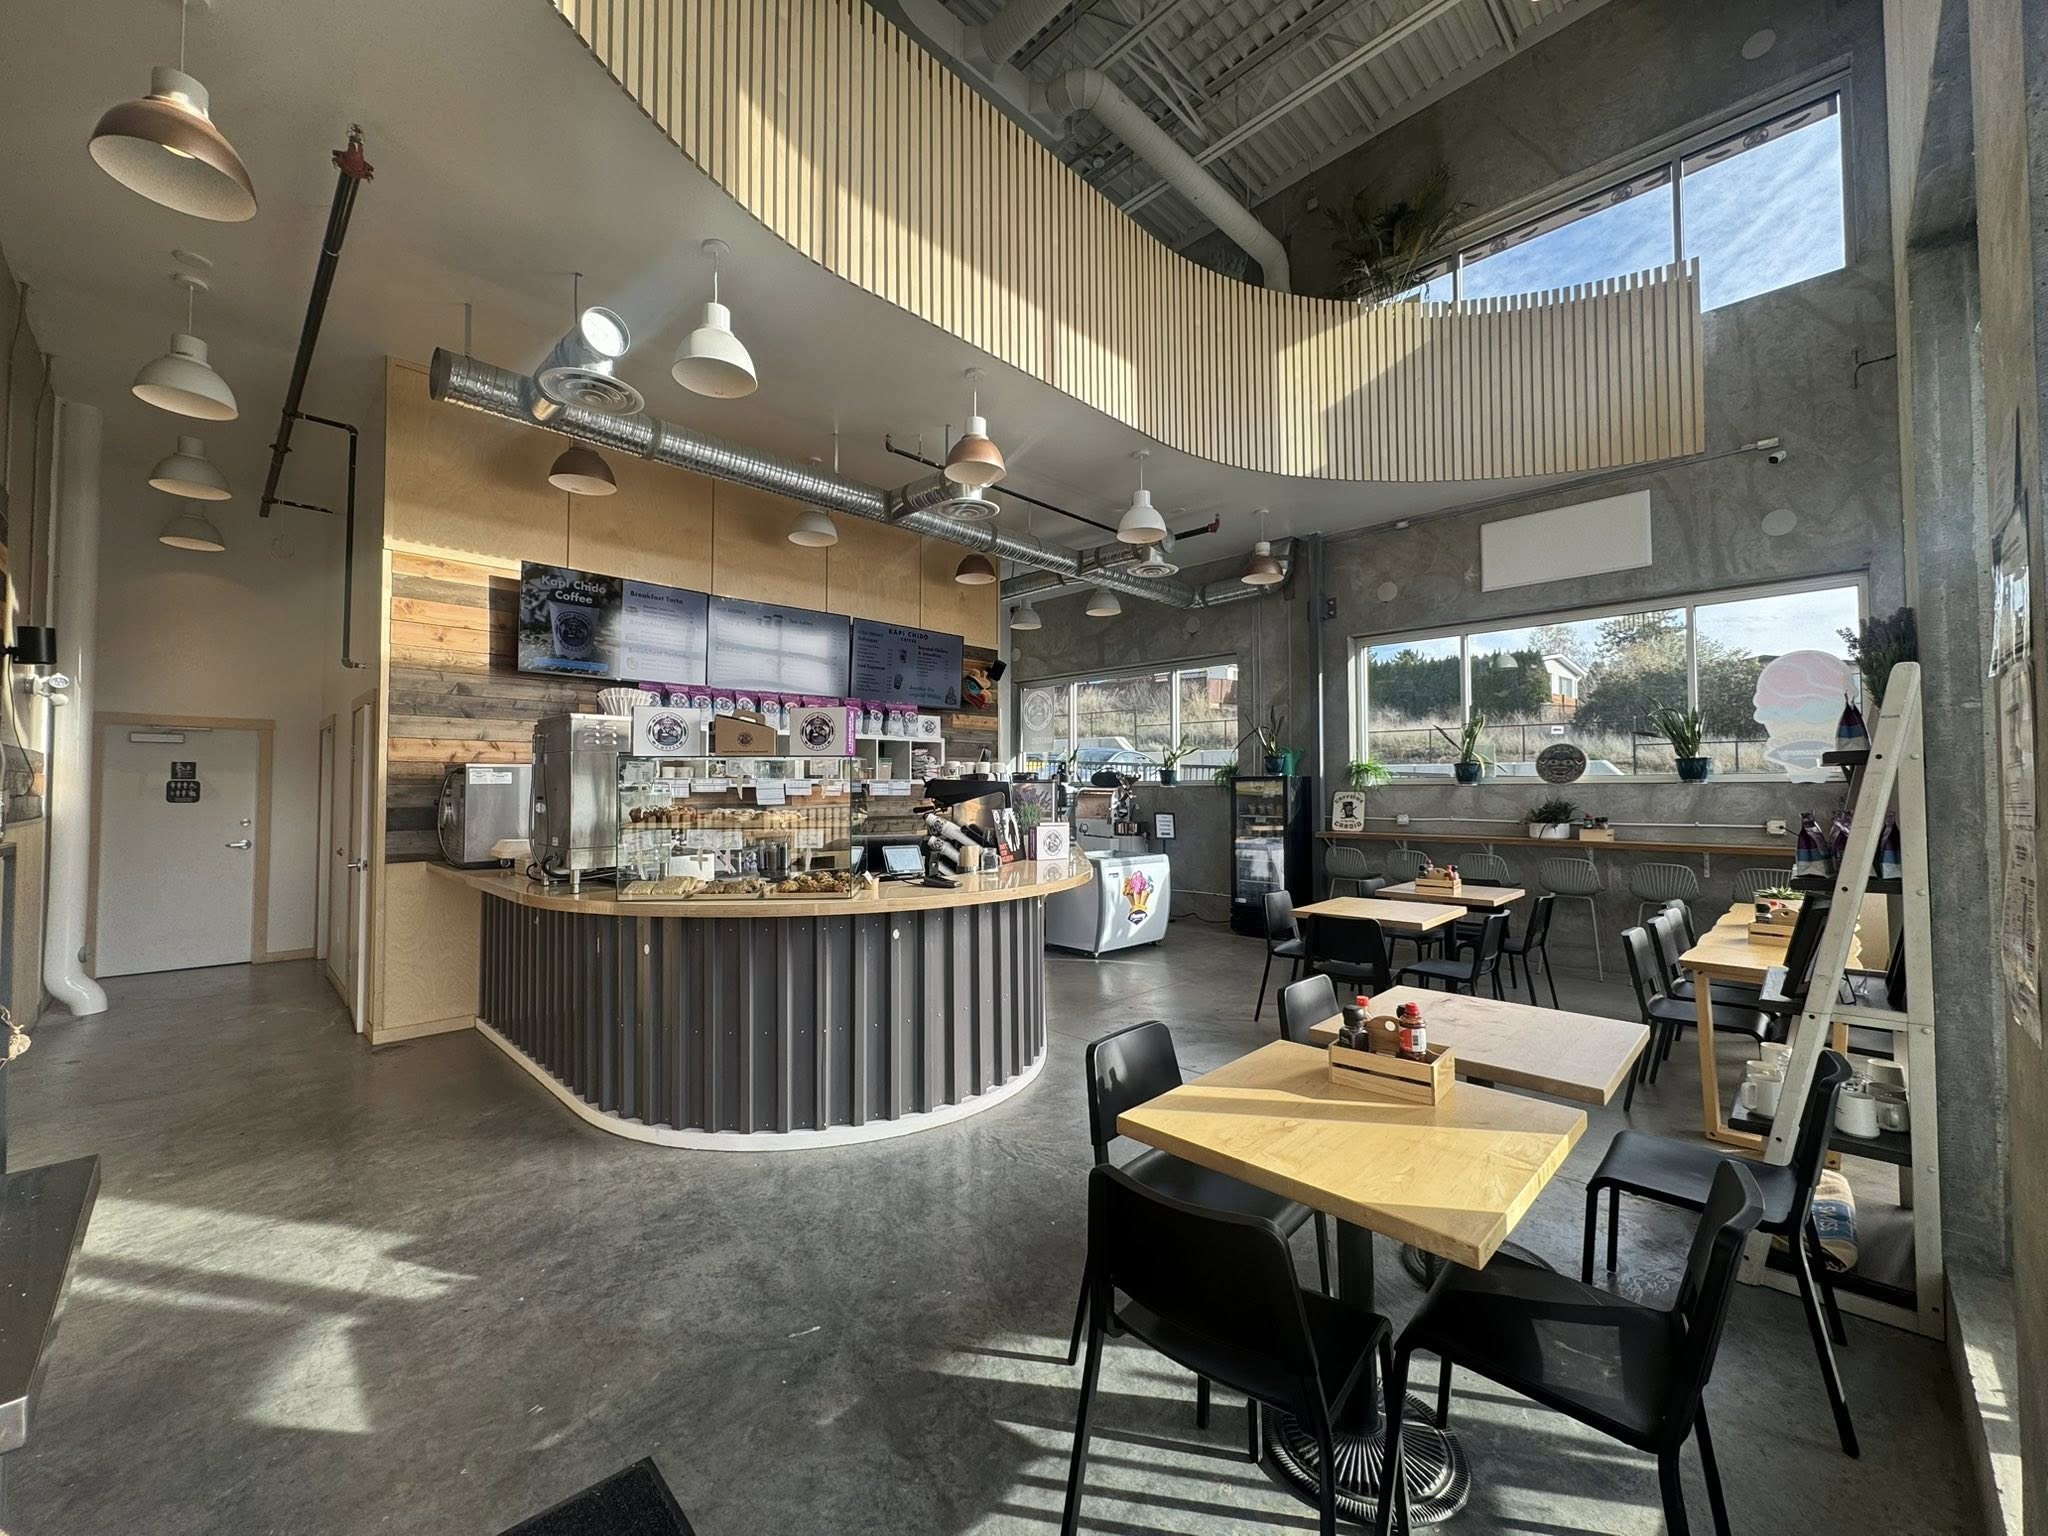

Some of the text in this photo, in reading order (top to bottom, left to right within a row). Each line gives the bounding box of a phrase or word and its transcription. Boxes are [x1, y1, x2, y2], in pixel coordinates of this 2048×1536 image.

[541, 575, 607, 594] Kapi Chido
[555, 590, 593, 604] Coffee
[630, 590, 684, 605] Breakfast Torta
[888, 628, 929, 640] KAPI CHIDO
[1334, 821, 1362, 829] CARDIO
